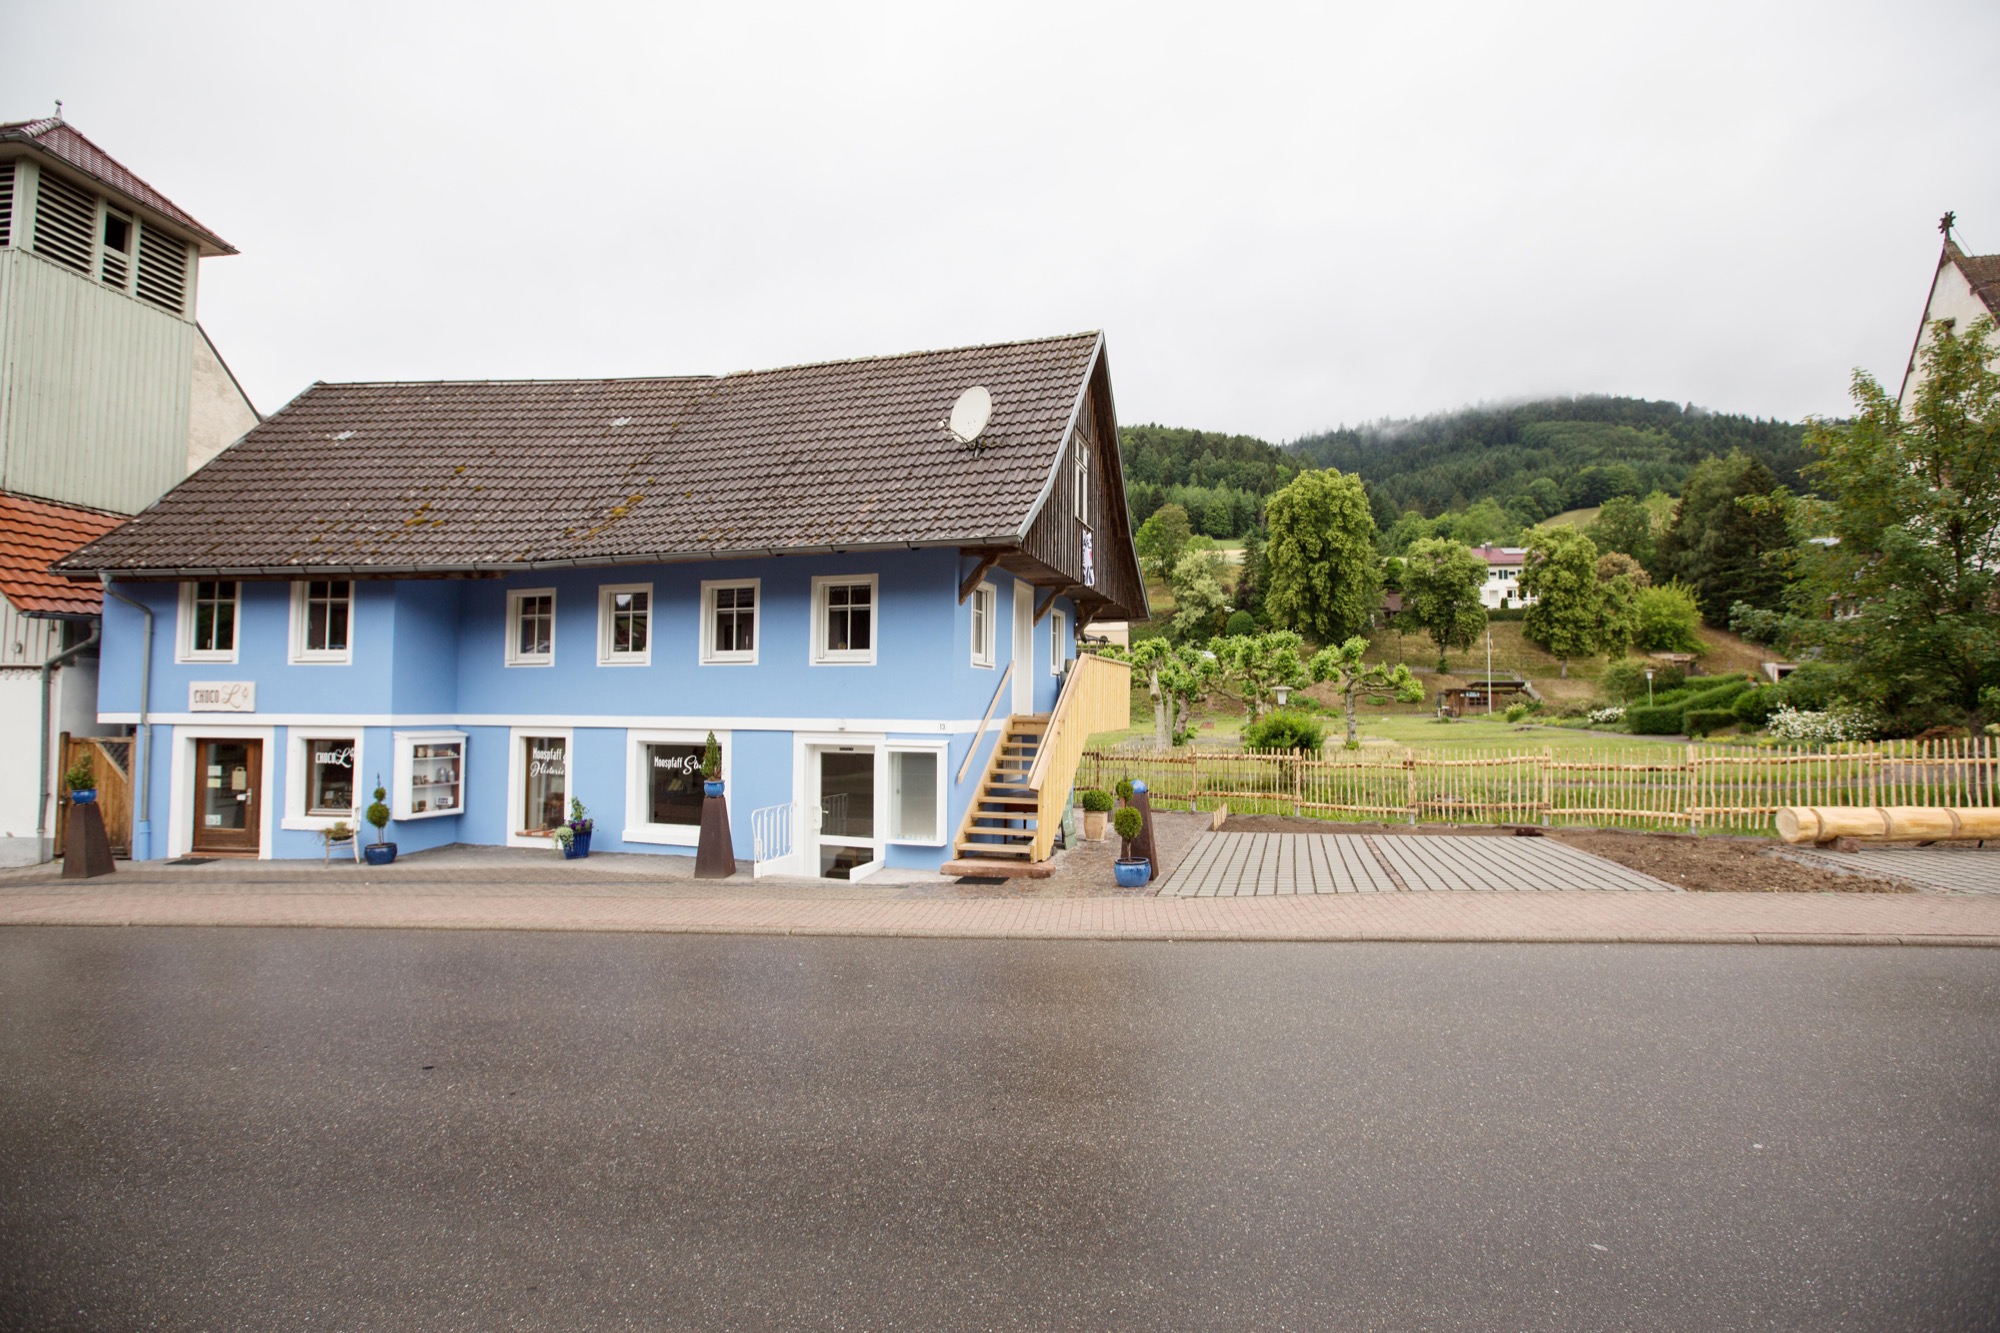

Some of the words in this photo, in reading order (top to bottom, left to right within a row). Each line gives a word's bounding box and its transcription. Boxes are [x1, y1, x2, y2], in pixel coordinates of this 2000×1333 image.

[194, 689, 220, 704] CHOCO
[222, 683, 241, 709] L
[315, 751, 336, 764] CHOCO
[532, 747, 562, 763] Moospfaff
[654, 756, 683, 770] Moospfaff
